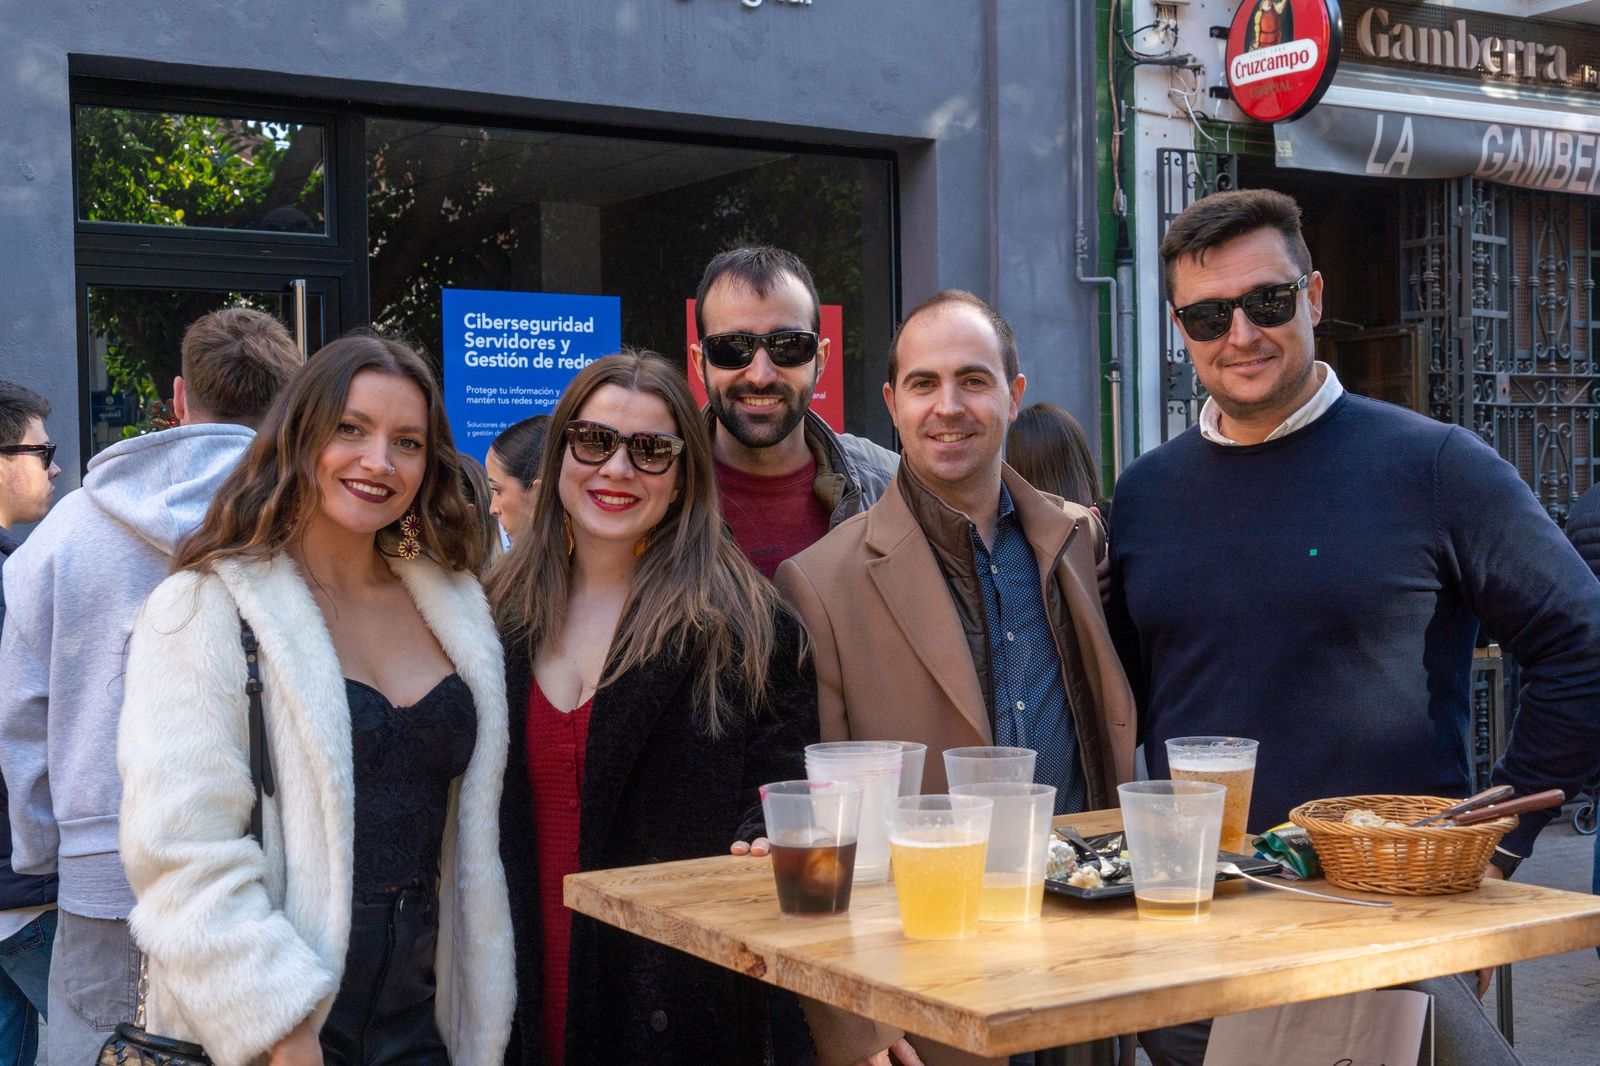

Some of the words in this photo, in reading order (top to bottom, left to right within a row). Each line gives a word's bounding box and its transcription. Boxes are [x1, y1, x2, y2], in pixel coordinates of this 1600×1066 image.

[1356, 7, 1568, 81] Gamberra
[1235, 49, 1309, 79] Cruzcampo
[1366, 114, 1414, 176] LA
[463, 312, 594, 335] Ciberseguridad
[464, 331, 556, 350] Servidores
[560, 339, 571, 354] y
[464, 351, 528, 368] Gestión
[532, 352, 554, 368] de
[466, 385, 497, 396] Protege
[500, 387, 508, 395] tu
[509, 386, 554, 395] información
[555, 389, 560, 397] y
[466, 396, 496, 404] mantén
[466, 420, 498, 428] Soluciones
